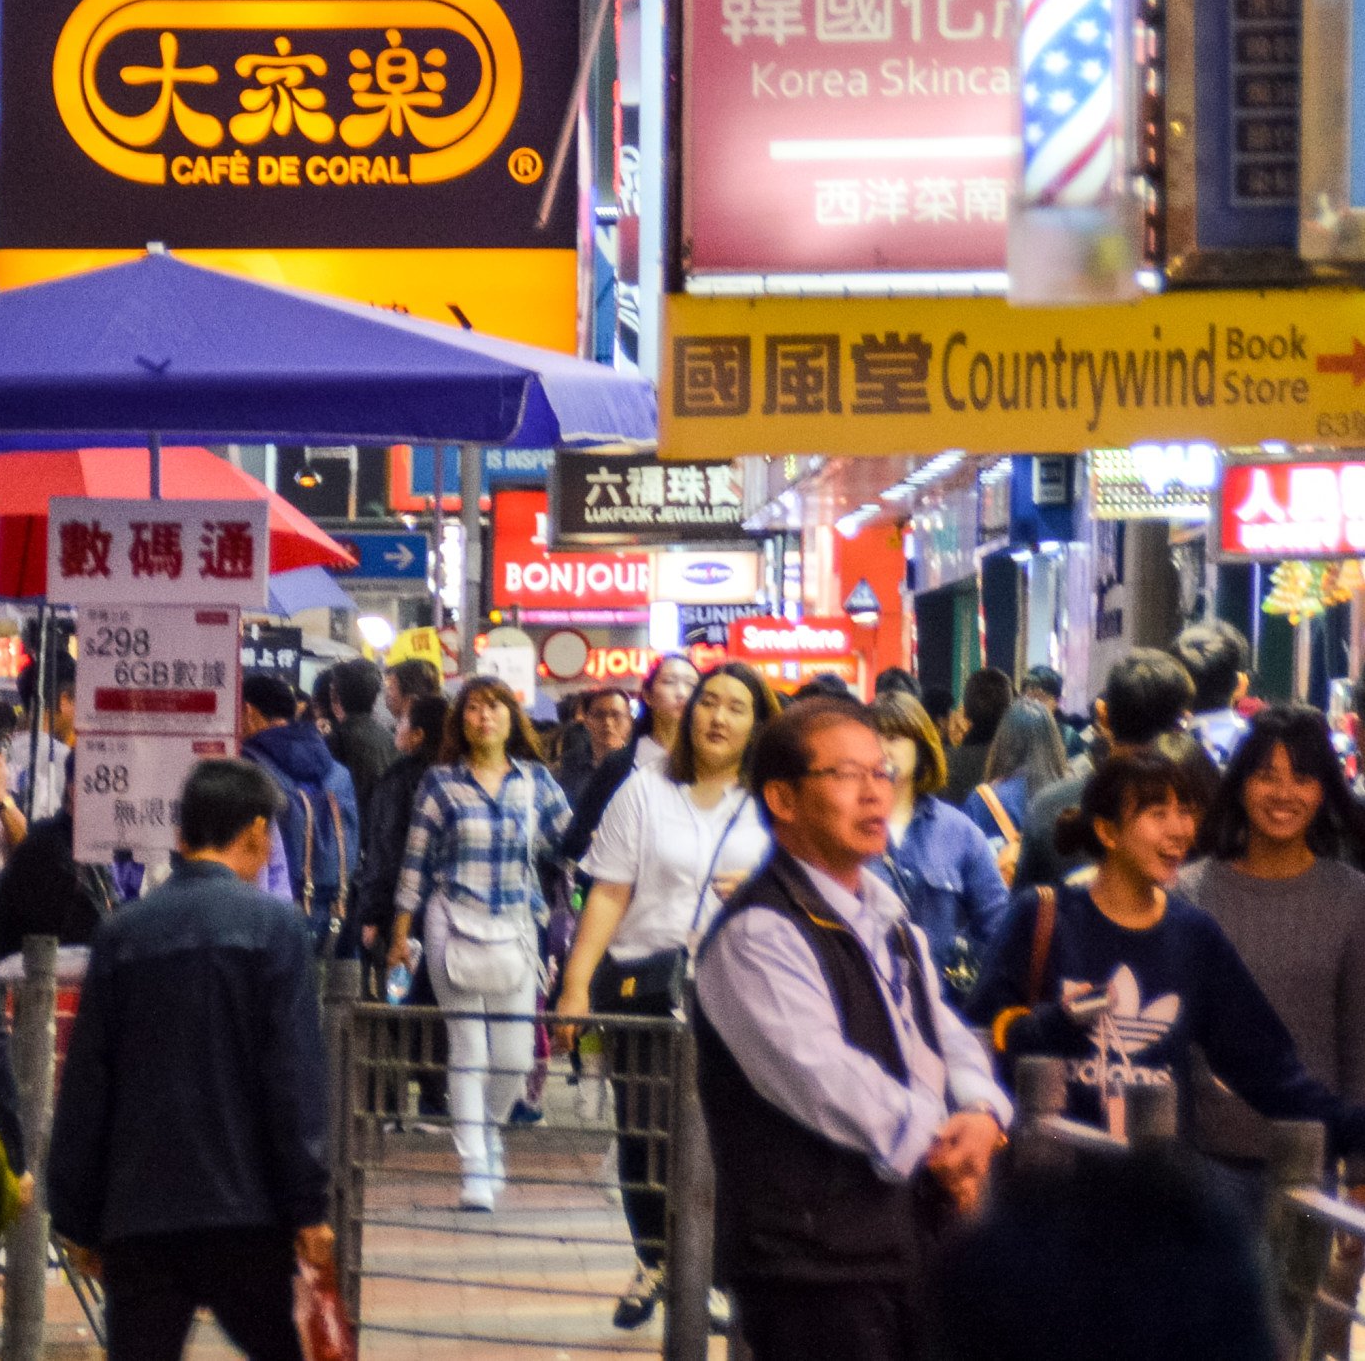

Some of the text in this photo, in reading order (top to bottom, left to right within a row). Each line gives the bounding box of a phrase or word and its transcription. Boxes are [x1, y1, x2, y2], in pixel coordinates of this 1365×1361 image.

[751, 58, 869, 99] Korea
[257, 155, 301, 185] DE
[305, 155, 409, 185] CORAL
[1226, 326, 1308, 361] Book
[673, 329, 933, 418] 國風堂
[941, 323, 1218, 432] Countrywind
[1222, 369, 1310, 406] Store
[60, 519, 256, 580] 數碼通
[85, 626, 152, 658] $298
[83, 764, 130, 795] $88
